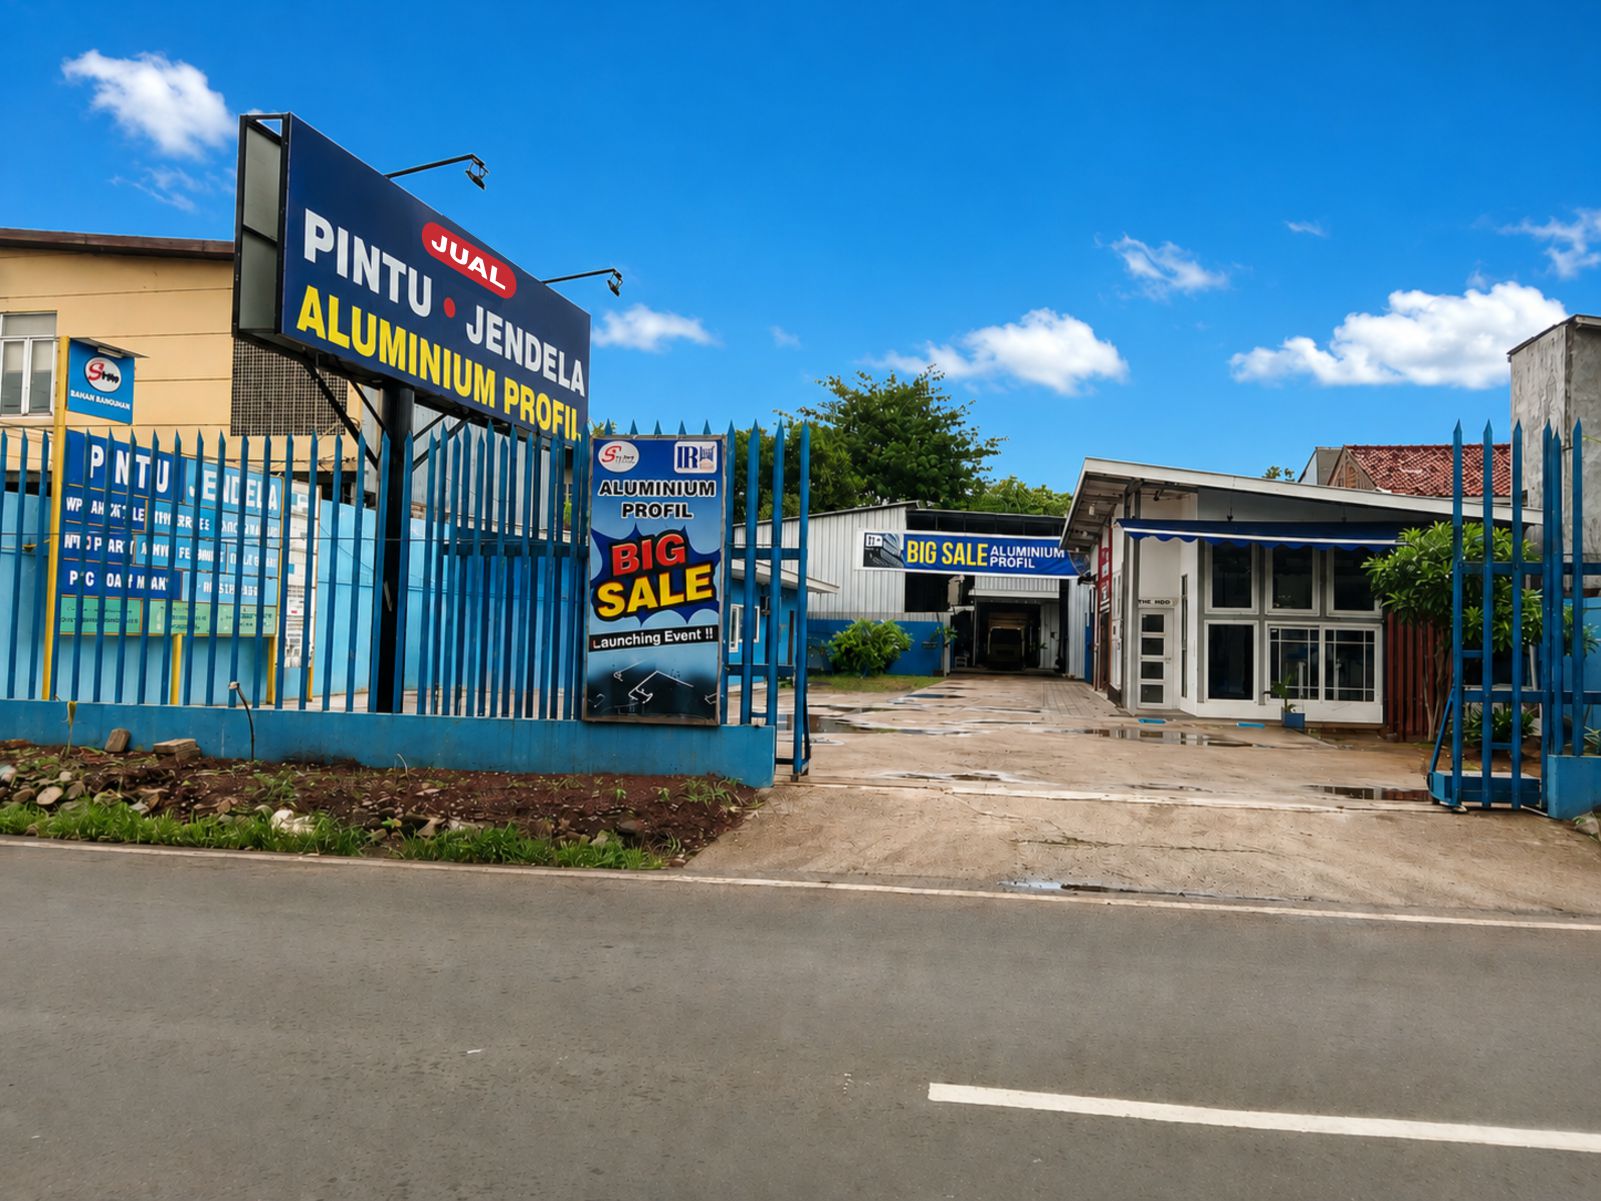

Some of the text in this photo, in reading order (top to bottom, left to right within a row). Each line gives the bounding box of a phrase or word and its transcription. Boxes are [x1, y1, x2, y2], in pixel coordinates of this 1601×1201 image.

[431, 235, 506, 290] JUAL
[303, 207, 586, 397] PINTU JENDELA
[296, 284, 582, 442] ALUMINIUM PROFIL
[90, 444, 170, 493] PNTU
[598, 480, 716, 497] ALUMINIUM
[621, 502, 694, 519] PROFIL
[611, 533, 686, 576] BIG
[906, 539, 988, 567] BIG SALE
[990, 545, 1065, 559] ALUMINIUM
[990, 556, 1036, 569] PROFIL
[596, 563, 713, 618] SALE
[593, 631, 661, 649] Launching
[664, 629, 701, 643] Event
